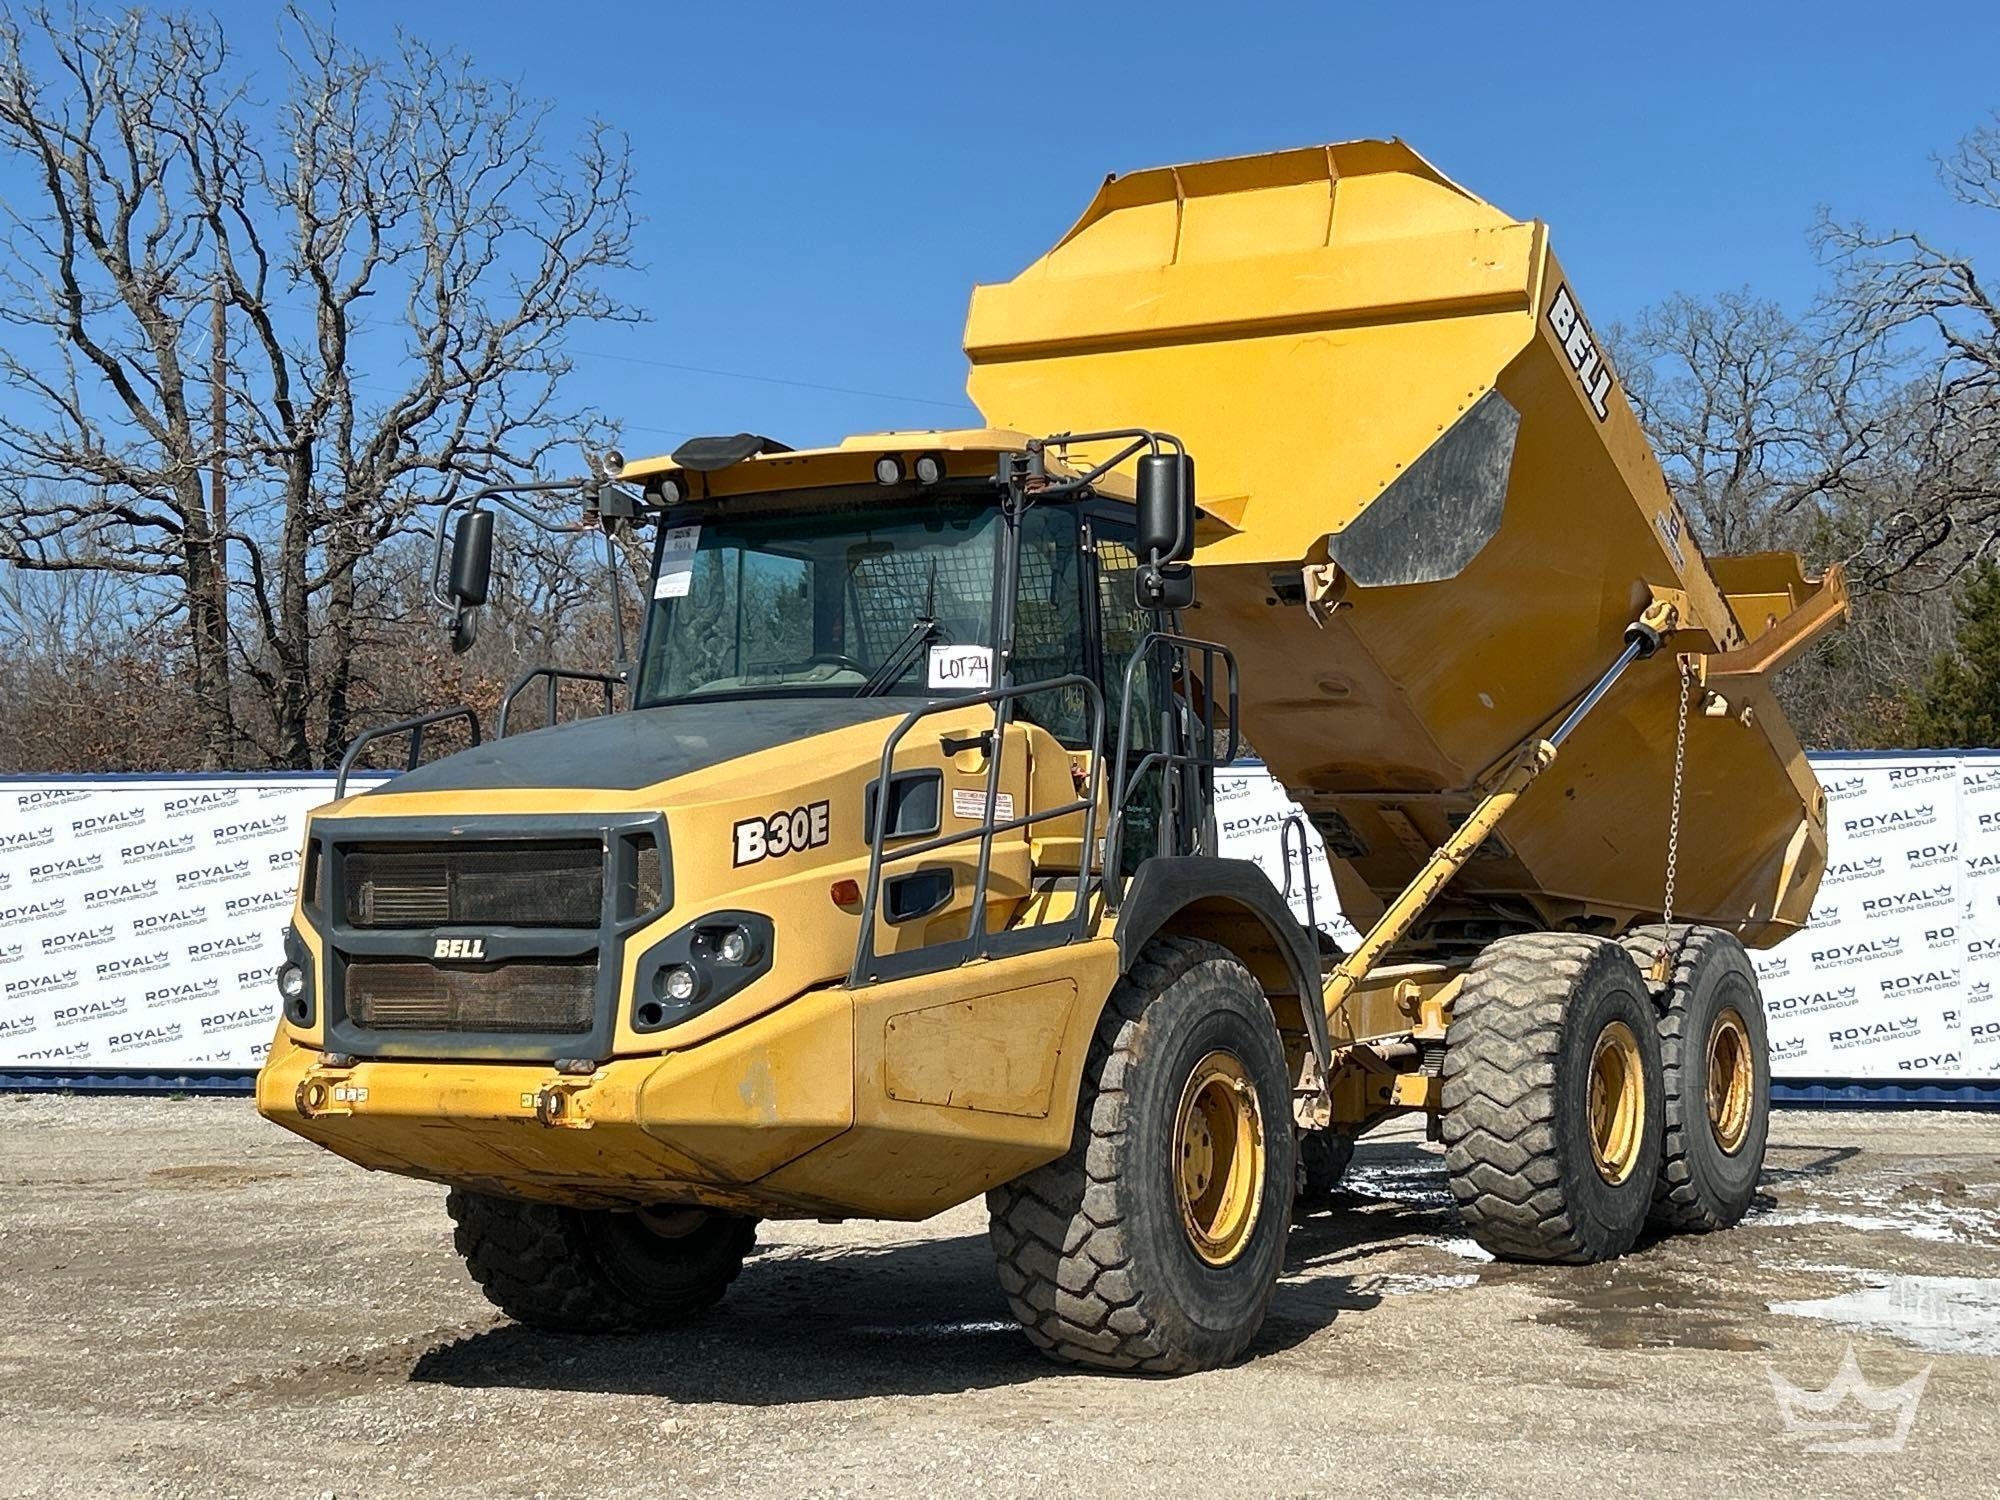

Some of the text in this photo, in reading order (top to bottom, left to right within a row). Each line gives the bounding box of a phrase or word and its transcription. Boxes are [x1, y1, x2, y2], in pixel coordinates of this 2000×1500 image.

[1547, 282, 1612, 422] BELL
[939, 656, 989, 683] LOT 74
[1892, 776, 1941, 789] AUCTION
[20, 793, 92, 813] AUCTION GROUP
[164, 793, 222, 812] ROYAL
[1216, 791, 1250, 802] GROUP
[1830, 788, 1867, 801] GROUP
[166, 800, 238, 819] AUCTION GROUP
[72, 812, 130, 831] ROYAL
[74, 818, 146, 838] AUCTION GROUP
[214, 819, 272, 838] ROYAL
[1223, 812, 1287, 832] ROYAL
[1845, 810, 1916, 831] ROYAL
[1848, 817, 1937, 839] AUCTION GROUP
[23, 837, 55, 848] GROUP
[216, 826, 288, 845] AUCTION GROUP
[734, 802, 829, 867] B30E
[1226, 827, 1270, 839] AUCTION
[121, 839, 178, 858] ROYAL
[123, 846, 196, 865] AUCTION GROUP
[29, 858, 86, 877] ROYAL
[1825, 860, 1864, 877] YAL
[1910, 855, 1958, 869] AUCTION
[31, 864, 104, 884] AUCTION GROUP
[176, 864, 234, 883] ROYAL
[178, 870, 250, 890] AUCTION GROUP
[1846, 869, 1885, 881] GROUP
[84, 884, 142, 903] ROYAL
[86, 890, 158, 910] AUCTION GROUP
[226, 891, 283, 910] ROYAL
[1863, 890, 1934, 911] ROYAL
[36, 909, 67, 921] GROUP
[228, 904, 267, 918] AUCTION
[1866, 897, 1955, 919] AUCTION GROUP
[133, 911, 190, 930] ROYAL
[135, 918, 208, 937] AUCTION GROUP
[42, 929, 100, 948] ROYAL
[44, 936, 116, 955] AUCTION GROUP
[189, 936, 246, 955] ROYAL
[191, 942, 264, 962] AUCTION GROUP
[434, 940, 484, 958] BELL
[1812, 941, 1882, 962] ROYAL
[96, 955, 154, 974] ROYAL
[1815, 948, 1904, 970] AUCTION GROUP
[98, 962, 170, 981] AUCTION GROUP
[1881, 970, 1951, 991] ROYAL
[5, 974, 62, 993] ROYAL
[7, 980, 80, 1000] AUCTION GROUP
[146, 982, 204, 1001] ROYAL
[1884, 986, 1932, 999] AUCTION
[148, 988, 220, 1008] AUCTION GROUP
[1768, 991, 1838, 1012] ROYAL
[54, 1001, 112, 1020] ROYAL
[56, 1008, 128, 1027] AUCTION GROUP
[201, 1009, 258, 1028] ROYAL
[1771, 998, 1860, 1020] AUCTION GROUP
[6, 1027, 37, 1039] GROUP
[203, 1016, 276, 1035] AUCTION GROUP
[1829, 1021, 1900, 1042] ROYAL
[109, 1027, 166, 1046] ROYAL
[111, 1034, 184, 1053] AUCTION GROUP
[1832, 1028, 1921, 1050] AUCTION GROUP
